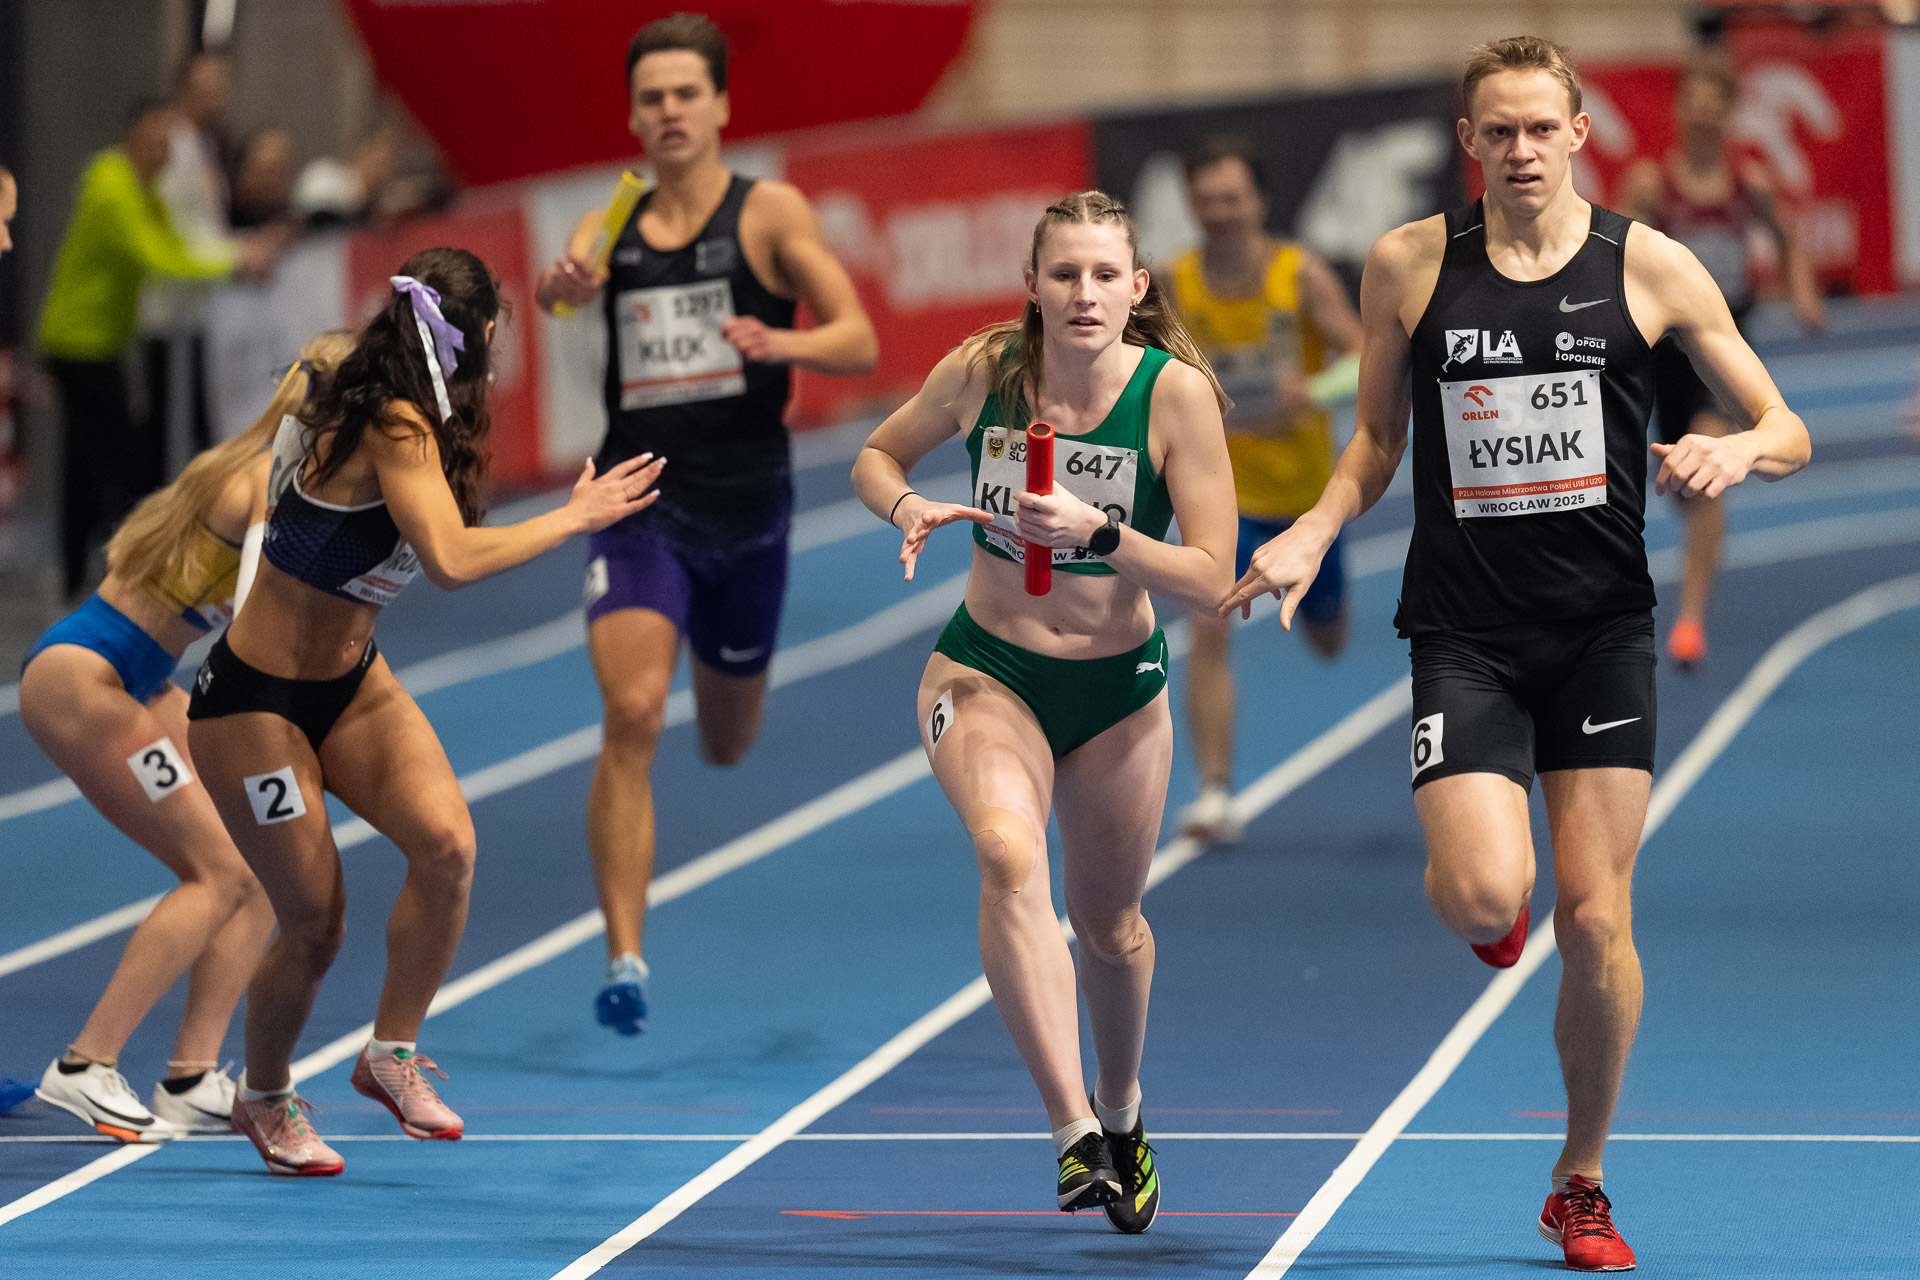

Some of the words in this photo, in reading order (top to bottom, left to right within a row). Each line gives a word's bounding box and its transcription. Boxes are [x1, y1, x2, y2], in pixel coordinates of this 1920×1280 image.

[1576, 339, 1606, 349] OPOLE
[1530, 380, 1588, 410] 651
[1462, 410, 1499, 421] ORLEN
[1010, 441, 1027, 452] DO
[1469, 429, 1585, 469] ŁYSIAK
[1066, 451, 1124, 480] 647
[1458, 489, 1474, 497] PZLA
[1502, 485, 1548, 496] Mistrzostwa
[1549, 482, 1572, 491] Polski
[1573, 480, 1585, 488] U18
[1589, 476, 1603, 485] U20
[1477, 498, 1551, 514] WROCŁAW
[1554, 494, 1585, 507] 2025
[932, 702, 945, 744] 6
[1414, 722, 1432, 768] 6
[142, 749, 178, 789] 3
[258, 777, 295, 820] 2
